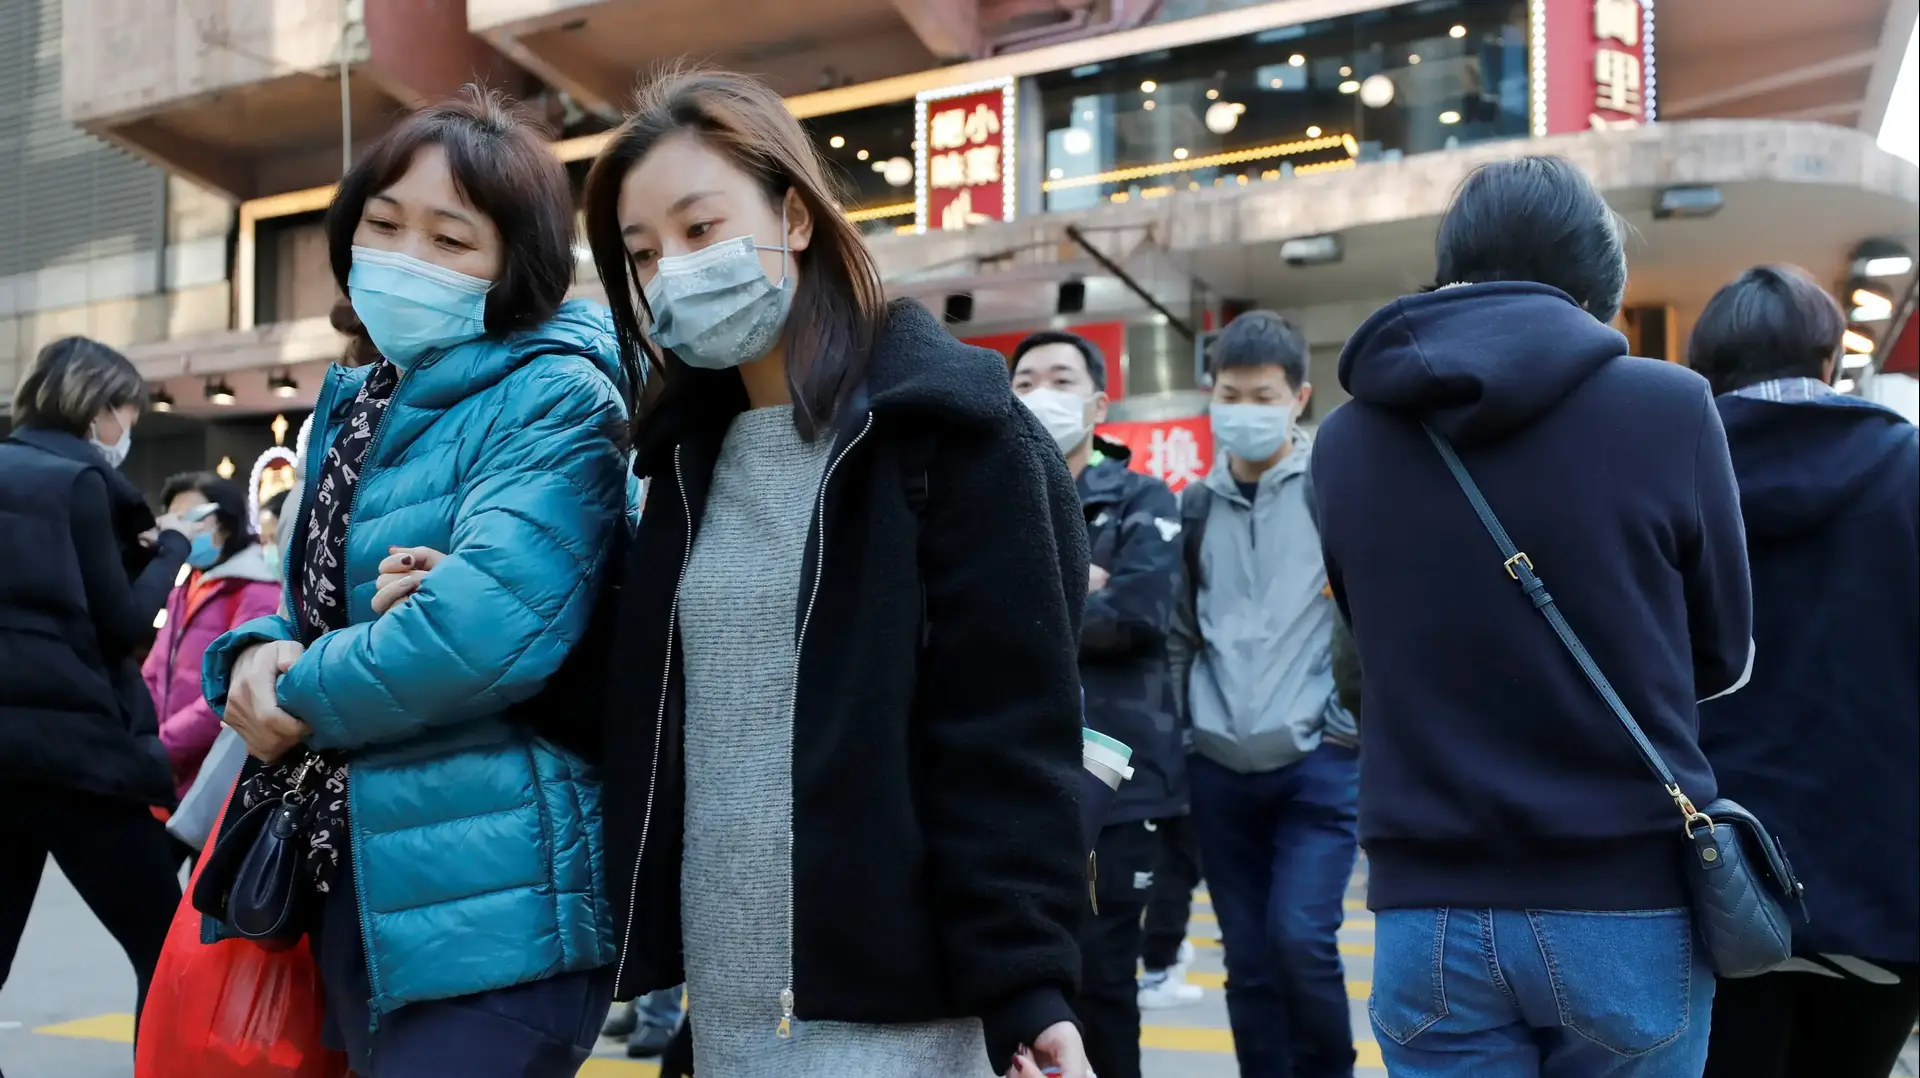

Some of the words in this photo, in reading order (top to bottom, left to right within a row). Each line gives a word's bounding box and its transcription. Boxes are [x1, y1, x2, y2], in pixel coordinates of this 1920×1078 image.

[351, 411, 372, 440] ABC
[318, 473, 336, 506] ABC
[317, 573, 337, 607] ABC
